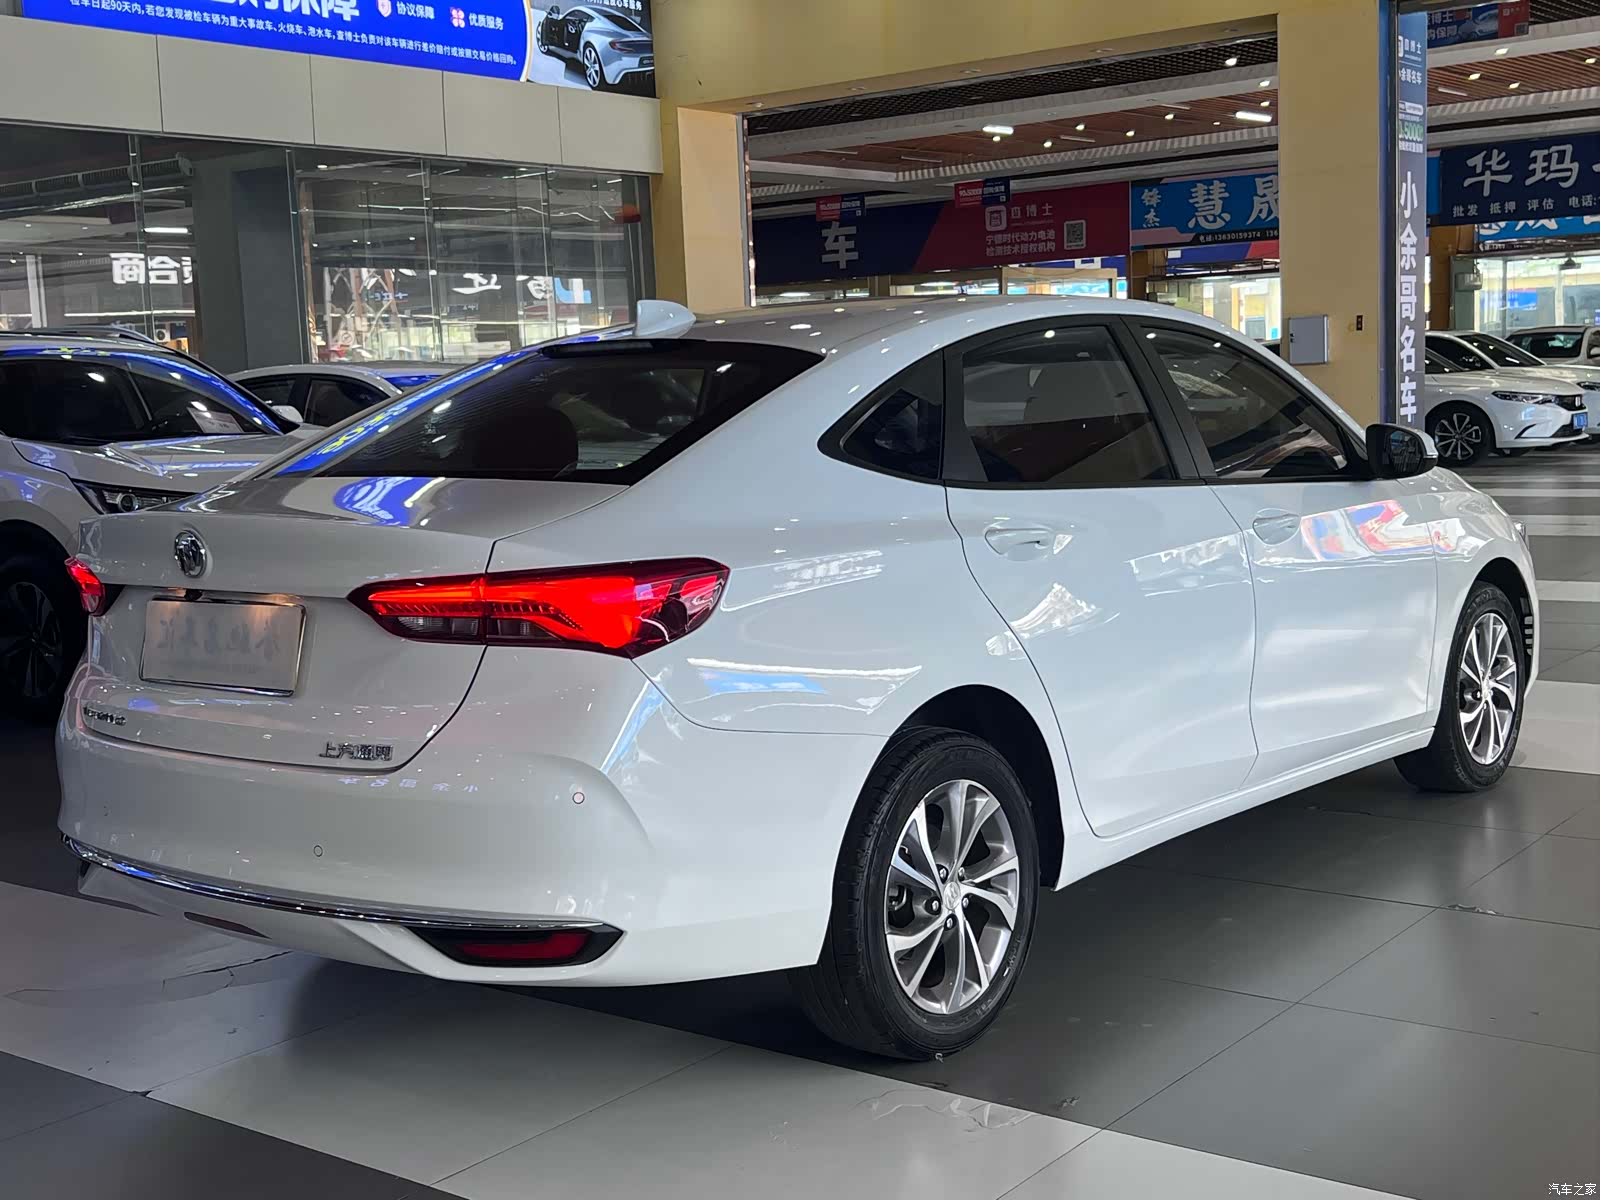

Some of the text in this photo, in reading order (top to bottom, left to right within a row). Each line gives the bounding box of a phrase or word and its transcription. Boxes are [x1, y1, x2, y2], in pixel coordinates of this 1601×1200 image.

[396, 2, 435, 20] 协议保障
[468, 12, 504, 30] 优质服务
[1427, 9, 1453, 25] 博士
[1463, 143, 1600, 197] 华玛
[1187, 174, 1279, 230] 慧晟
[1452, 204, 1478, 218] 批发
[1490, 201, 1516, 215] 抵押
[1527, 198, 1554, 212] 评估
[821, 221, 860, 269] 车
[1399, 171, 1418, 423] 小余哥名车
